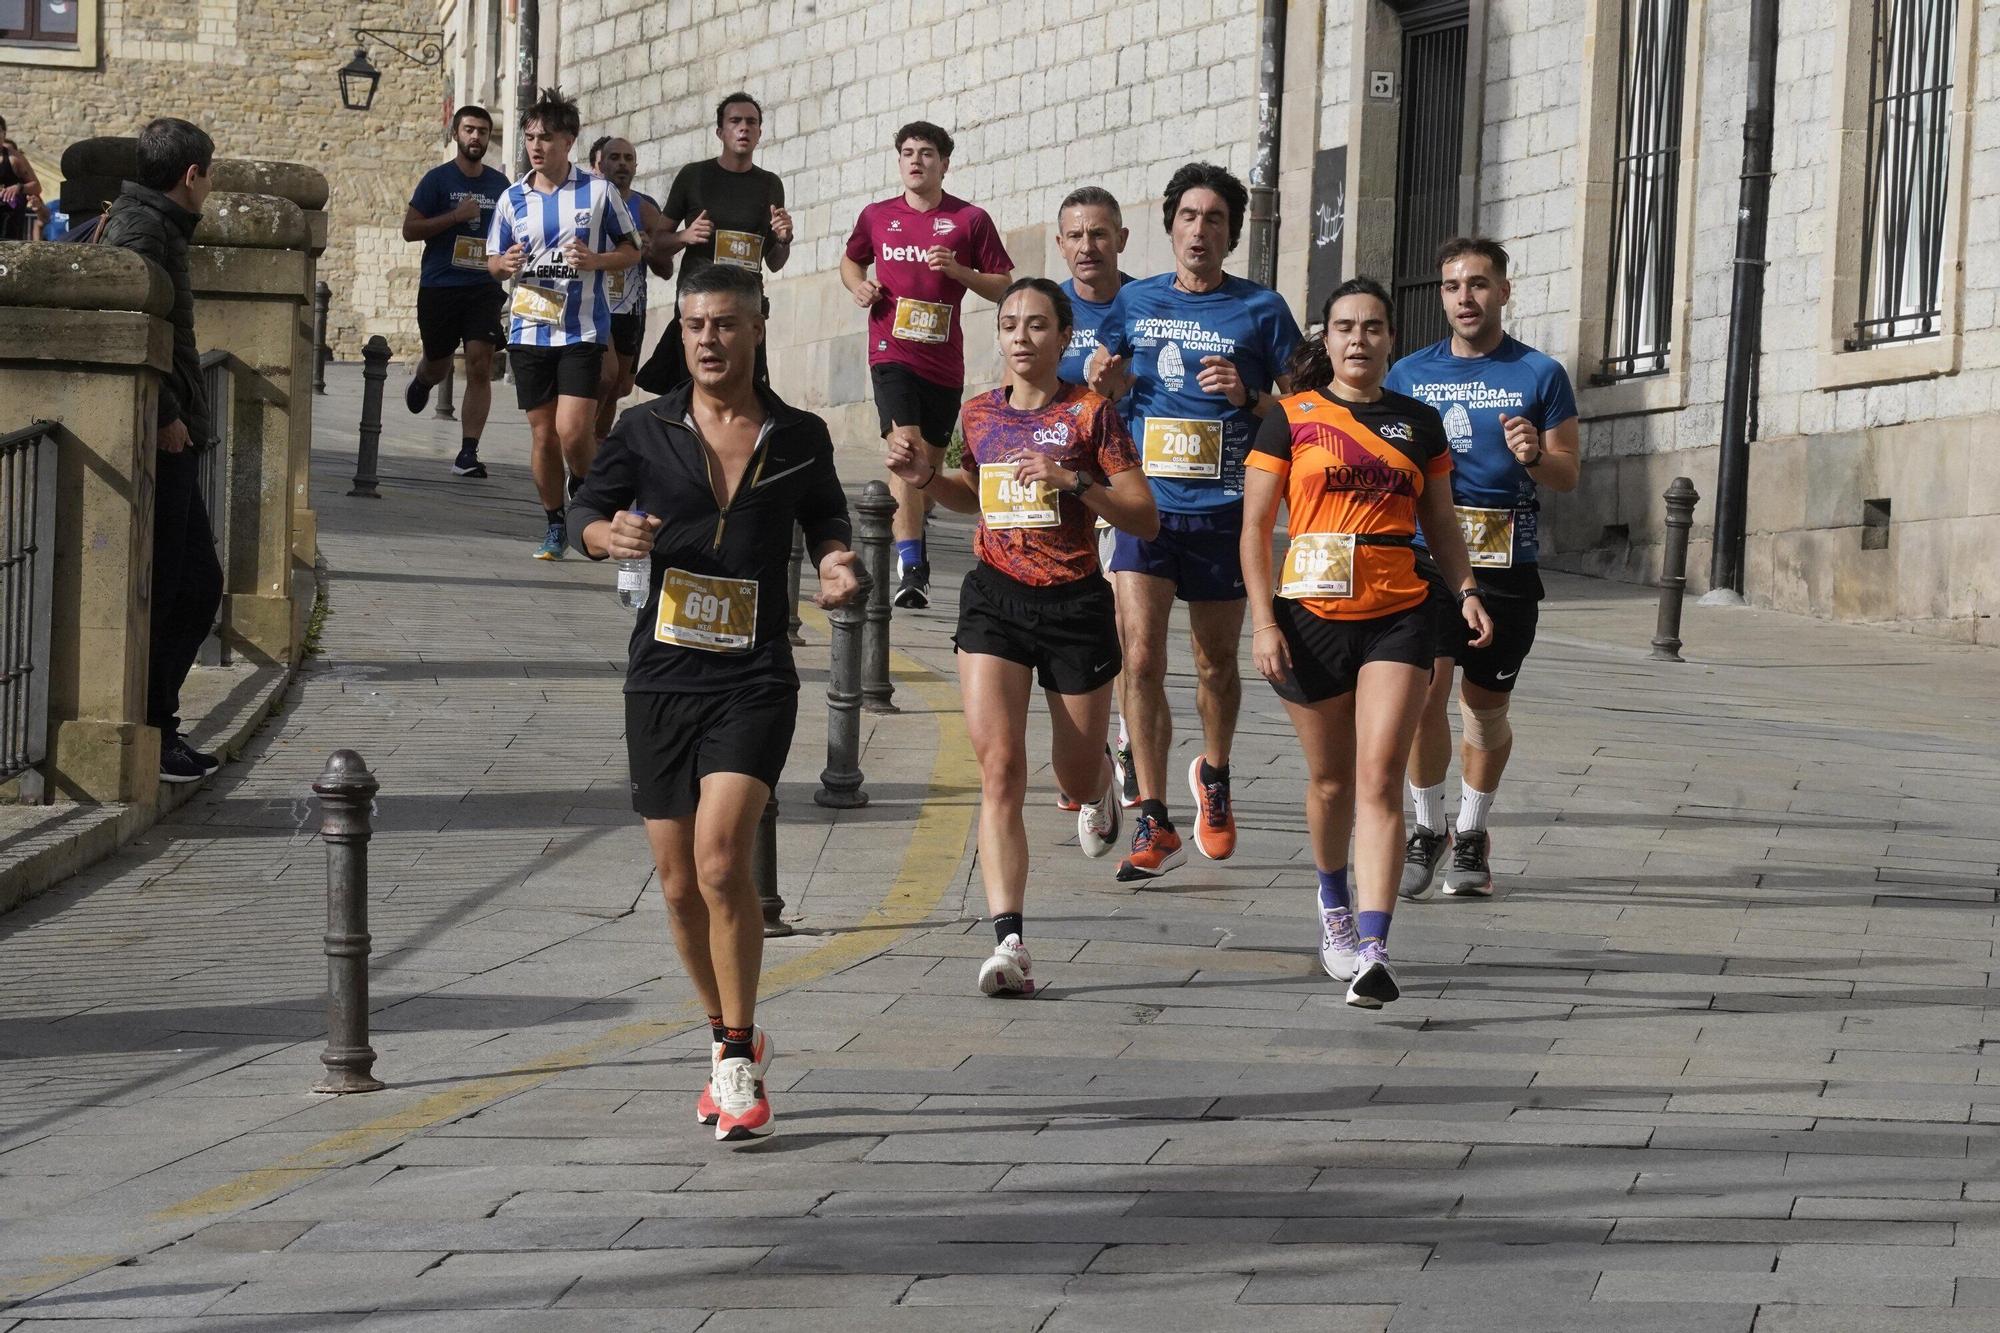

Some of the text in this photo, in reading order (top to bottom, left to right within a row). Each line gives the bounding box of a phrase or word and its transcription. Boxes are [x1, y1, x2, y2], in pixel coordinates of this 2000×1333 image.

[1375, 75, 1389, 93] 5
[551, 252, 563, 263] LA
[882, 243, 929, 263] betw
[537, 265, 579, 279] GENERAL
[909, 310, 938, 329] 686
[1145, 319, 1200, 331] CONQUISTA
[1144, 327, 1221, 344] ALMENDRA
[1182, 341, 1235, 354] KONKISTA
[1412, 381, 1486, 393] LA CONQUISTA
[1426, 388, 1508, 402] ALMENDRA
[1469, 399, 1523, 409] KONKISTA
[1162, 432, 1201, 456] 208
[998, 480, 1036, 503] 499
[685, 592, 731, 624] 691
